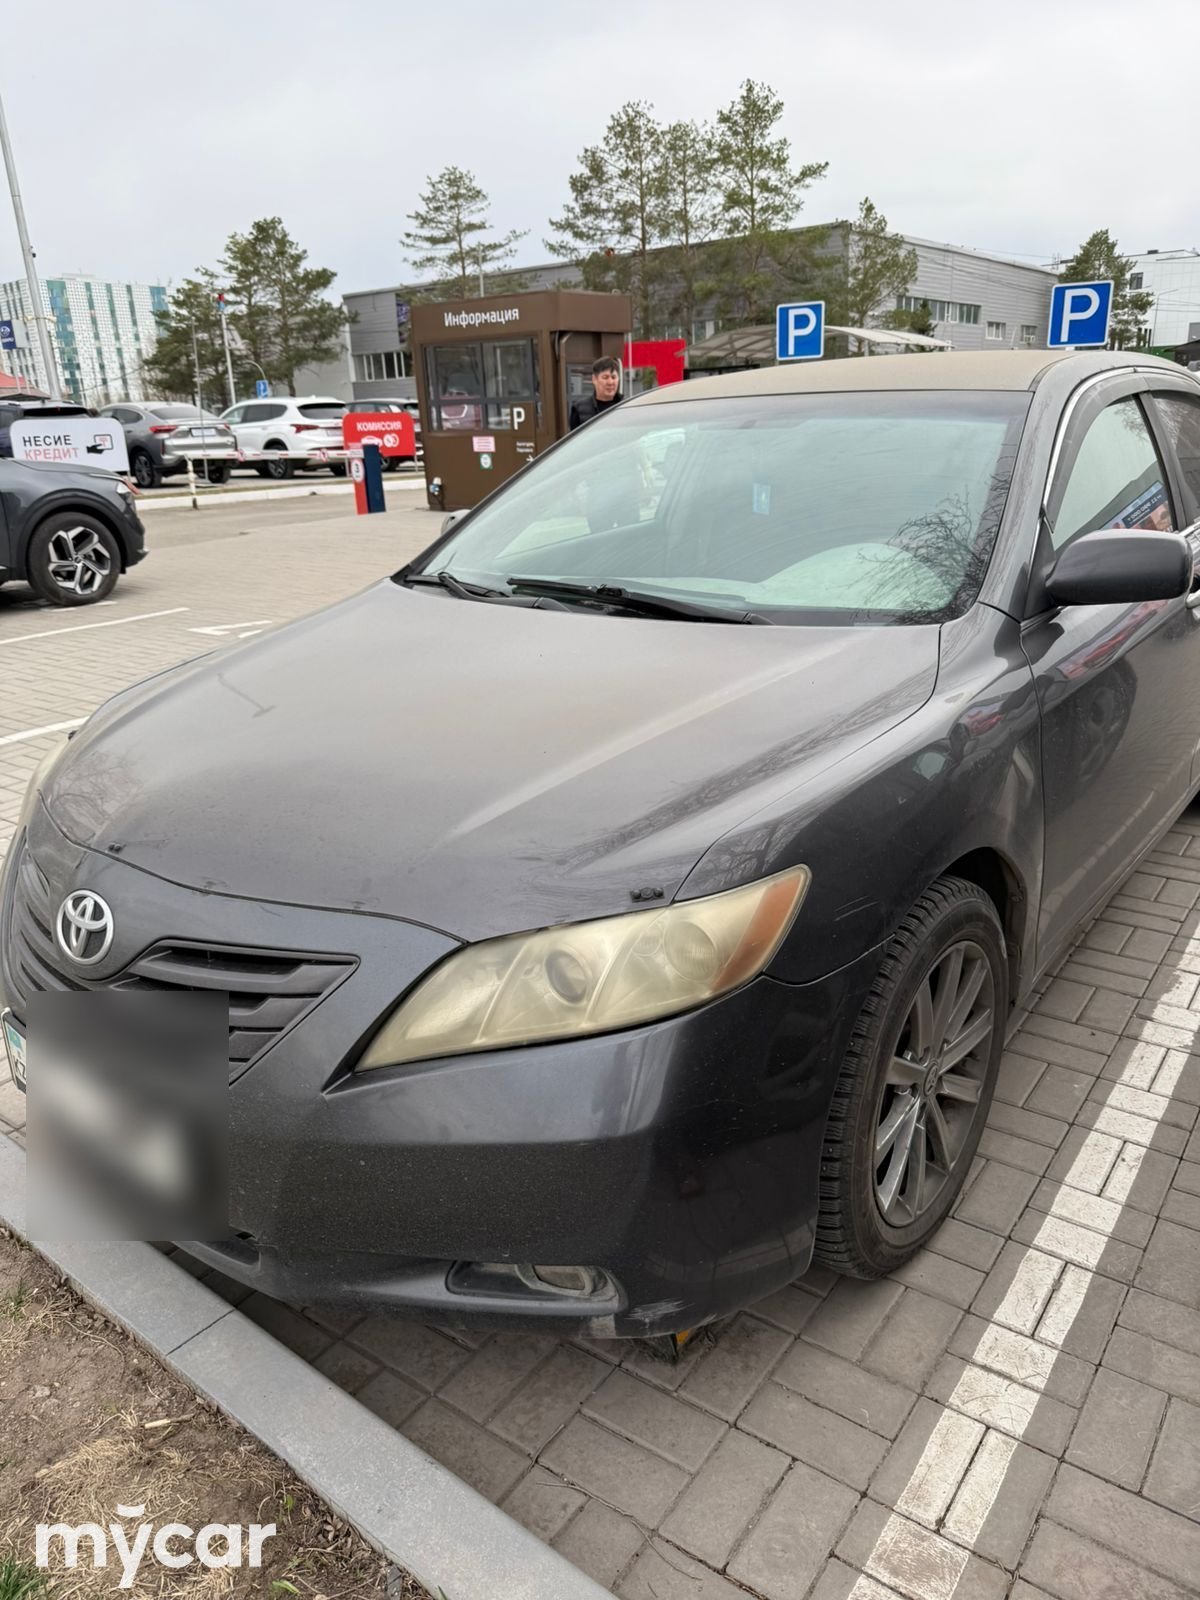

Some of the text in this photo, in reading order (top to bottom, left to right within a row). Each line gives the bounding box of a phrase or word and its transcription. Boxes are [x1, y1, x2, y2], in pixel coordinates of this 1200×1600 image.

[444, 308, 519, 328] Информация
[1061, 287, 1101, 343] P
[788, 308, 817, 356] P
[356, 421, 402, 431] КОМИССИЯ
[22, 435, 72, 446] НЕСИЕ
[24, 448, 79, 461] КРЕДИТ
